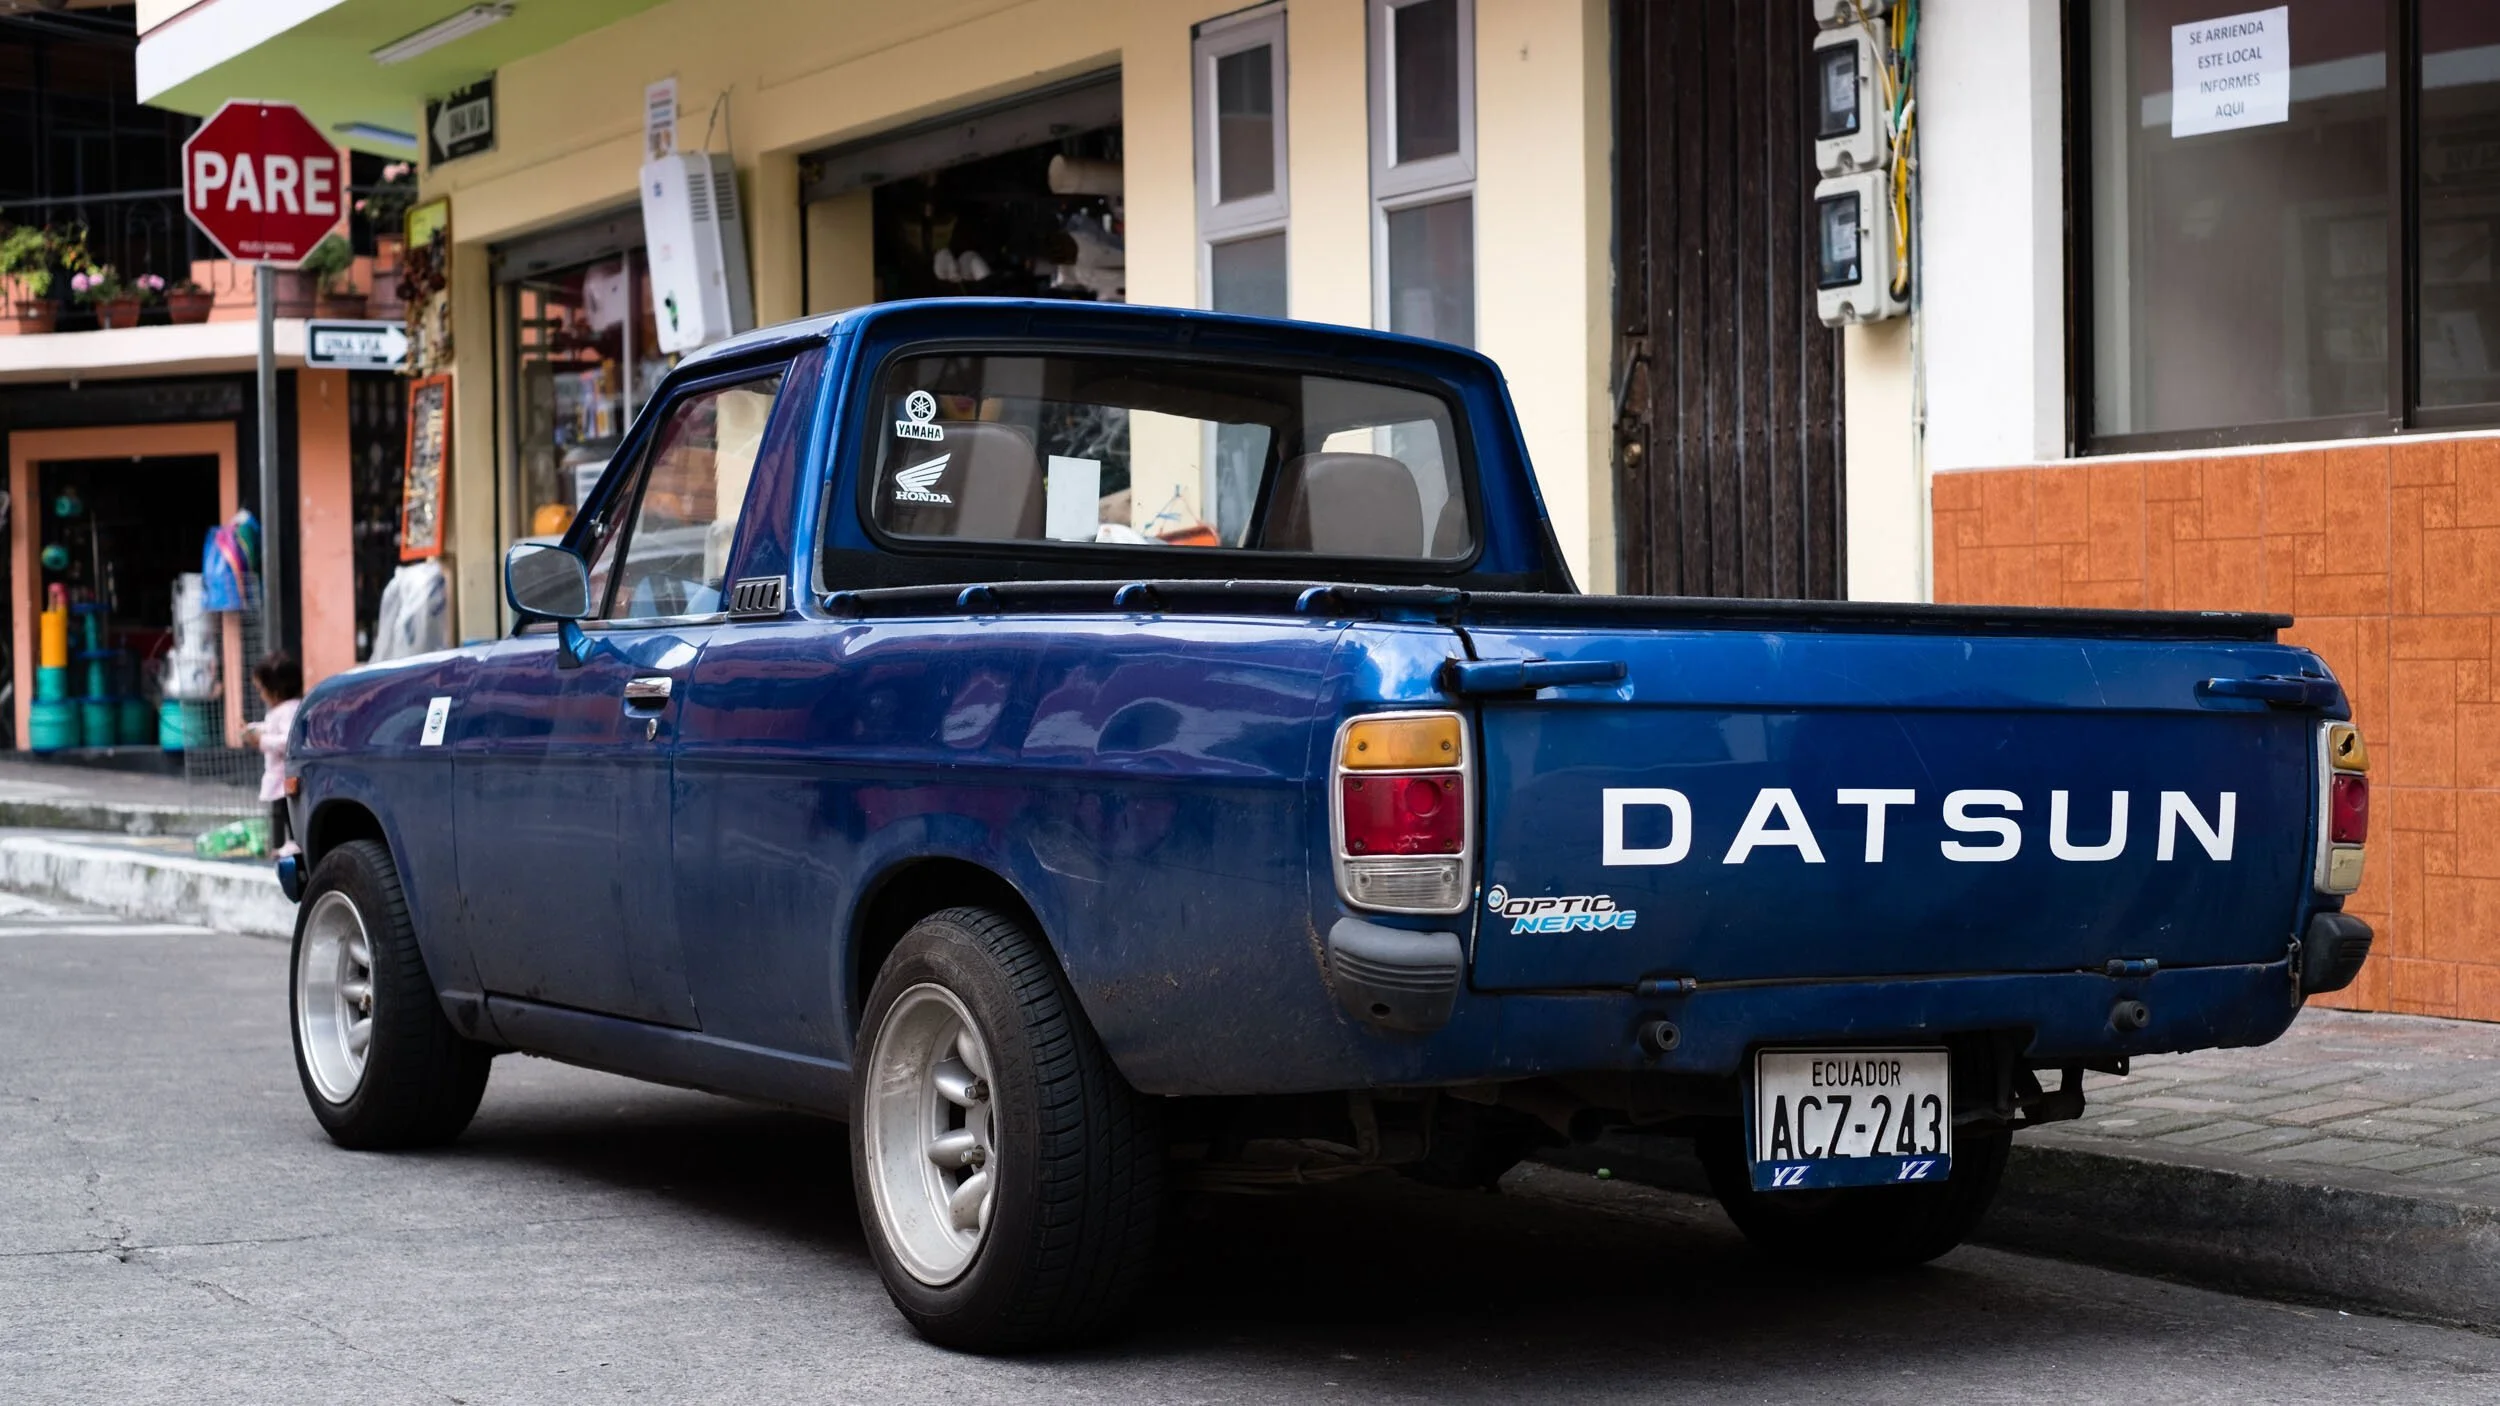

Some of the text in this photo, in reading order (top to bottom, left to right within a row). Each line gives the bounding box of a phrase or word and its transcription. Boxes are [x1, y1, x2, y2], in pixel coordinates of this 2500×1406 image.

[2189, 20, 2264, 45] SE ARRIENDA
[2197, 46, 2262, 69] ESTE LOCAL
[2200, 72, 2260, 94] INFORMES
[2215, 101, 2245, 118] AQUI
[194, 151, 335, 216] PARE
[898, 423, 941, 439] YAMAHA
[896, 491, 952, 503] HONDA
[1602, 788, 2237, 866] DATSUN
[1503, 897, 1614, 916] OPTIC
[1512, 910, 1637, 933] NERVE
[1812, 1061, 1901, 1087] ECUADOR
[1770, 1094, 1942, 1160] ACZ-243
[1772, 1160, 1936, 1187] YZ YZ
